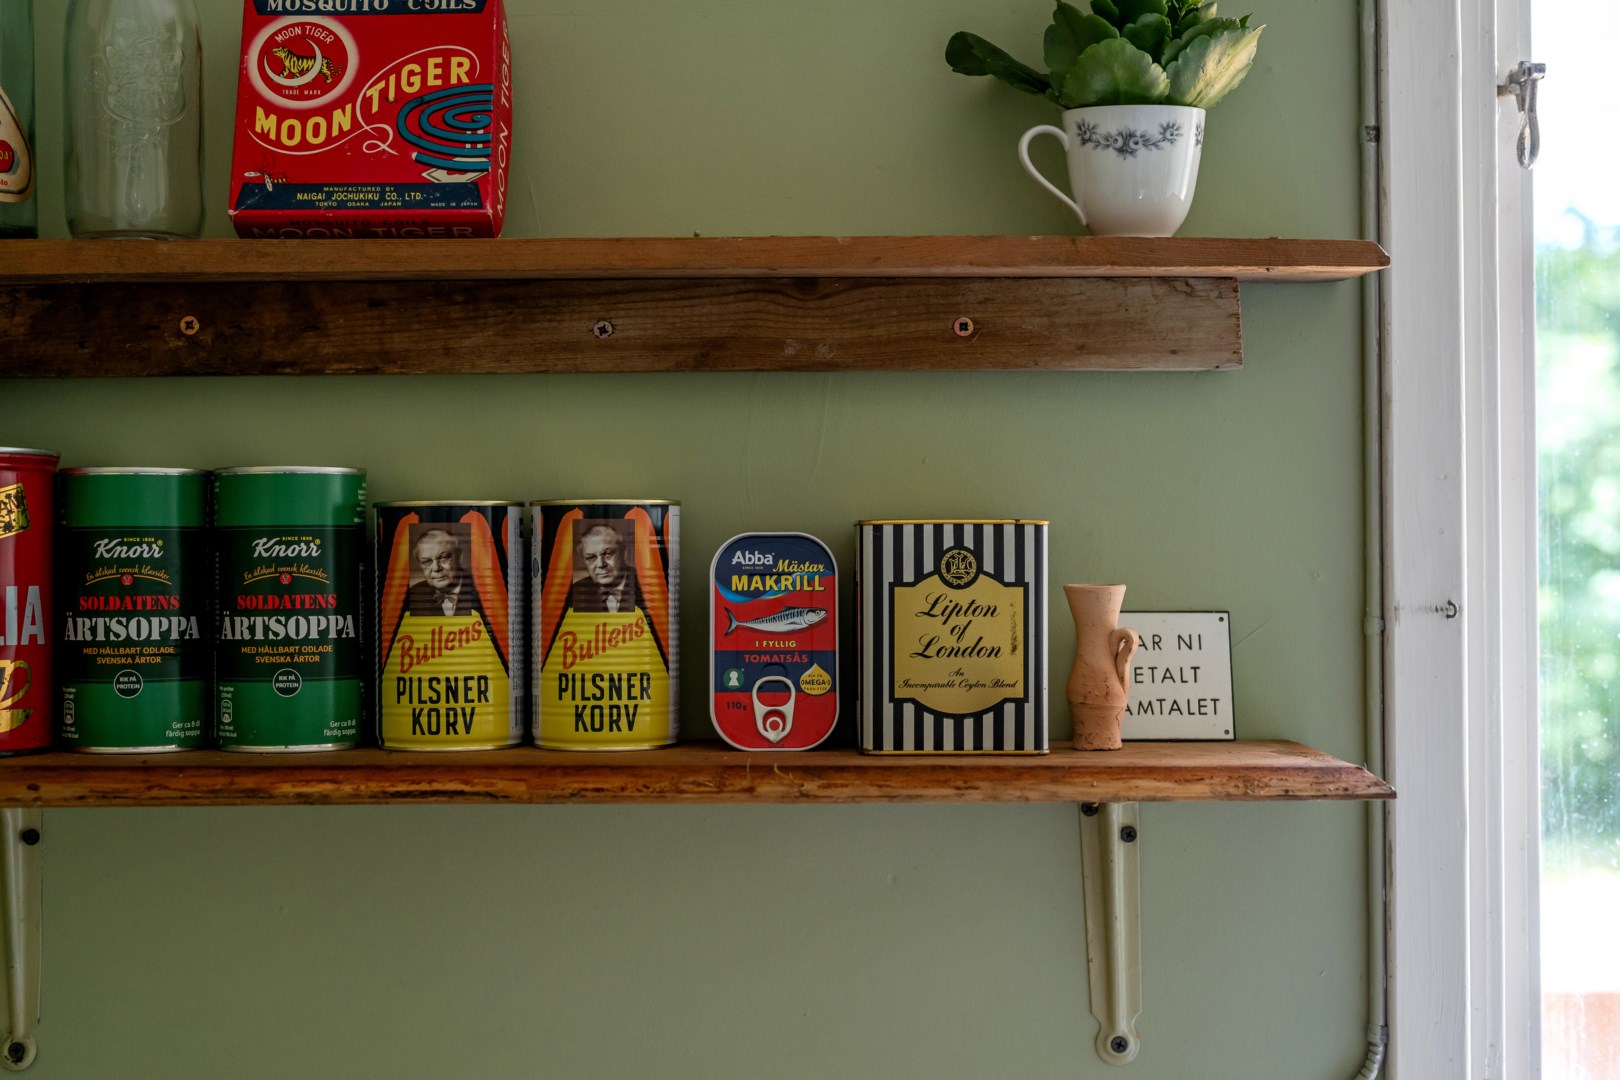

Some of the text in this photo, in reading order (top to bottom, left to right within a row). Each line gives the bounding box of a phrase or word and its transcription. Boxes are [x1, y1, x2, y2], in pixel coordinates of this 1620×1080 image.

[274, 25, 335, 44] MOON TIGER
[254, 103, 353, 147] MOON
[365, 56, 471, 114] TIGER
[497, 121, 509, 217] MOON
[296, 192, 326, 200] NAIGAI
[331, 192, 380, 200] JOCHUKIKU
[252, 226, 474, 238] MOON TIGER
[93, 538, 164, 559] Knorr
[251, 537, 322, 558] Knorr
[731, 550, 773, 565] Abba
[772, 559, 826, 573] Mästar
[731, 574, 825, 592] MAKRILL
[79, 595, 181, 611] SOLDATENS
[237, 593, 337, 610] SOLDATENS
[914, 592, 1000, 625] Lipton
[0, 585, 45, 646] IA
[64, 611, 200, 642] ÄRTSOPPA
[221, 611, 356, 641] ÄRTSOPPA
[949, 619, 973, 643] of
[83, 646, 175, 655] MED HÅLLBART ODLADE
[241, 645, 333, 654] MED HÅLLBART ODLADE
[395, 619, 482, 675] Bullens
[558, 615, 646, 671] Bullens
[755, 640, 797, 648] I FYLLIG
[909, 633, 1003, 659] London
[1177, 633, 1203, 651] NI
[96, 655, 162, 665] SVENSKA ÄRTOR
[255, 653, 321, 664] SVENSKA ÄRTOR
[744, 653, 809, 664] TOMATSÅS
[948, 667, 965, 677] An
[396, 674, 490, 705] PILSNER
[558, 671, 652, 702] PILSNER
[898, 678, 1019, 693] Incomparable Ceylon Blend
[172, 721, 183, 729] Ger
[329, 720, 341, 728] Ger
[412, 706, 476, 736] KORV
[574, 703, 639, 733] KORV
[165, 729, 185, 738] färdig
